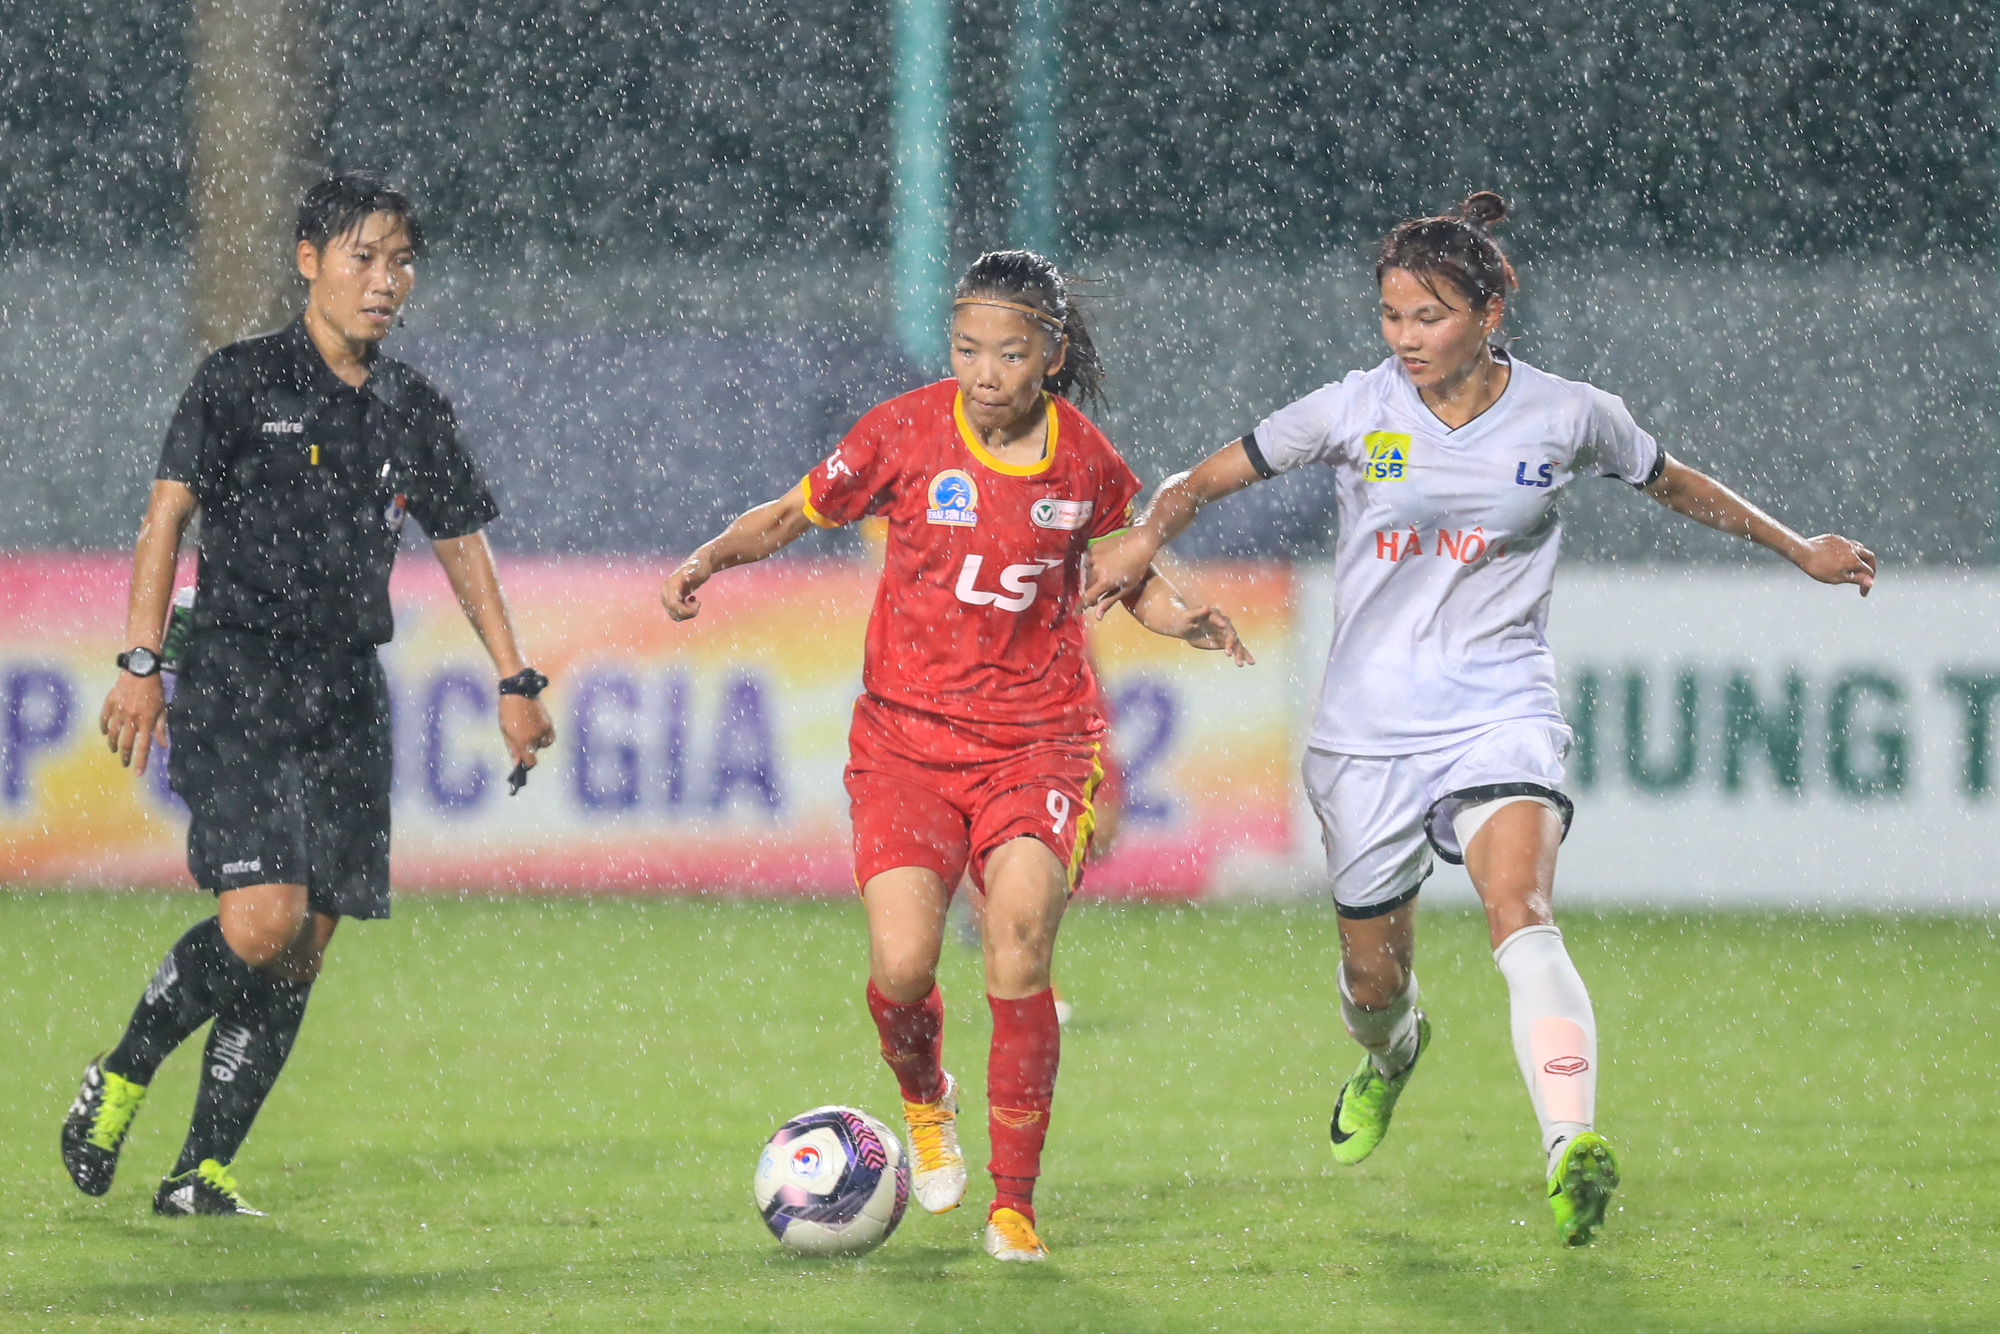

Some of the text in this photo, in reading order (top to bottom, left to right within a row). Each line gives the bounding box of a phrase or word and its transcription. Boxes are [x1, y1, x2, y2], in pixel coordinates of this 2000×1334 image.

[262, 419, 303, 434] mitre
[1515, 460, 1556, 488] LS
[1376, 525, 1422, 562] HÀ
[954, 554, 1050, 612] LS
[570, 664, 782, 812] GIA
[1046, 788, 1070, 833] 9
[222, 859, 261, 874] mitre
[211, 1024, 252, 1082] mitre
